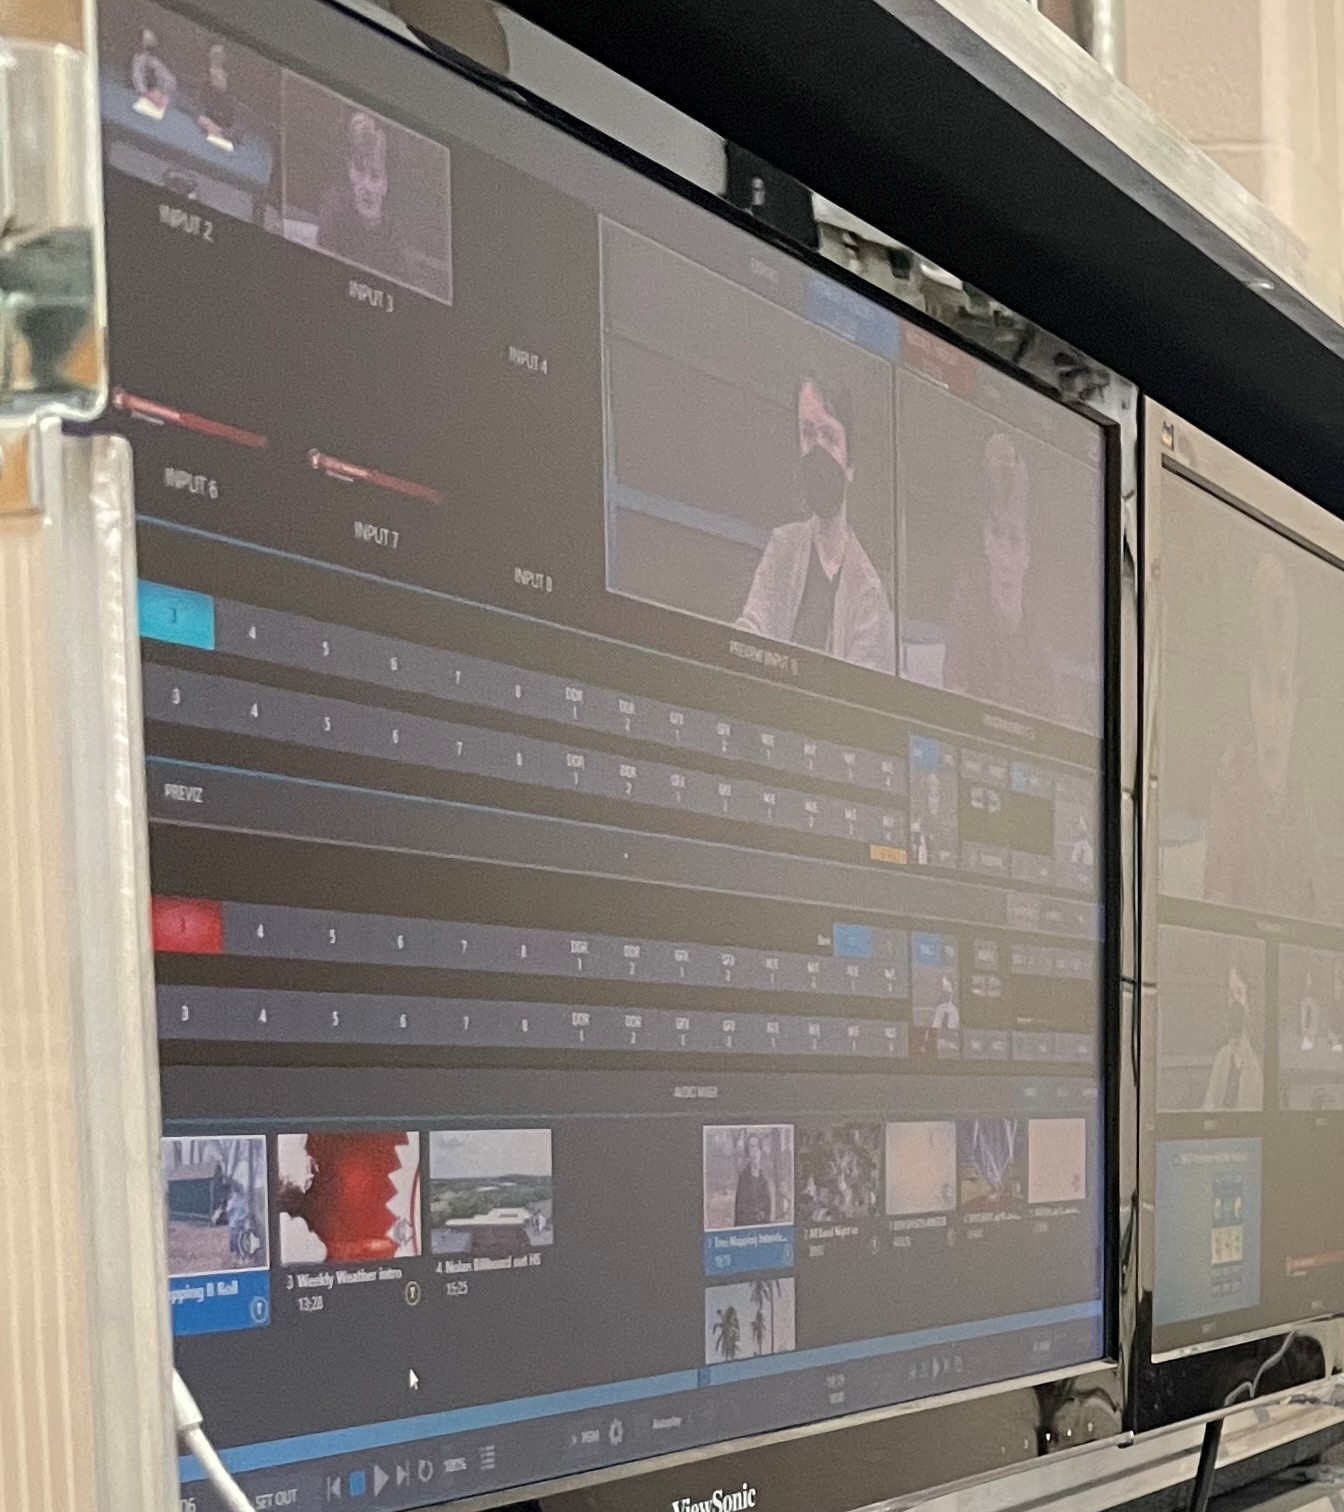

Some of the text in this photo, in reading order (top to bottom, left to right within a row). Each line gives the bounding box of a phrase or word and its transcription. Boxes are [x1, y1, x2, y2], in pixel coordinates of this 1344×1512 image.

[159, 205, 214, 242] INPUT 2
[349, 280, 383, 308] INPUT
[509, 346, 537, 371] INPUT
[164, 466, 204, 496] INPUT
[354, 520, 399, 549] INPUT 7
